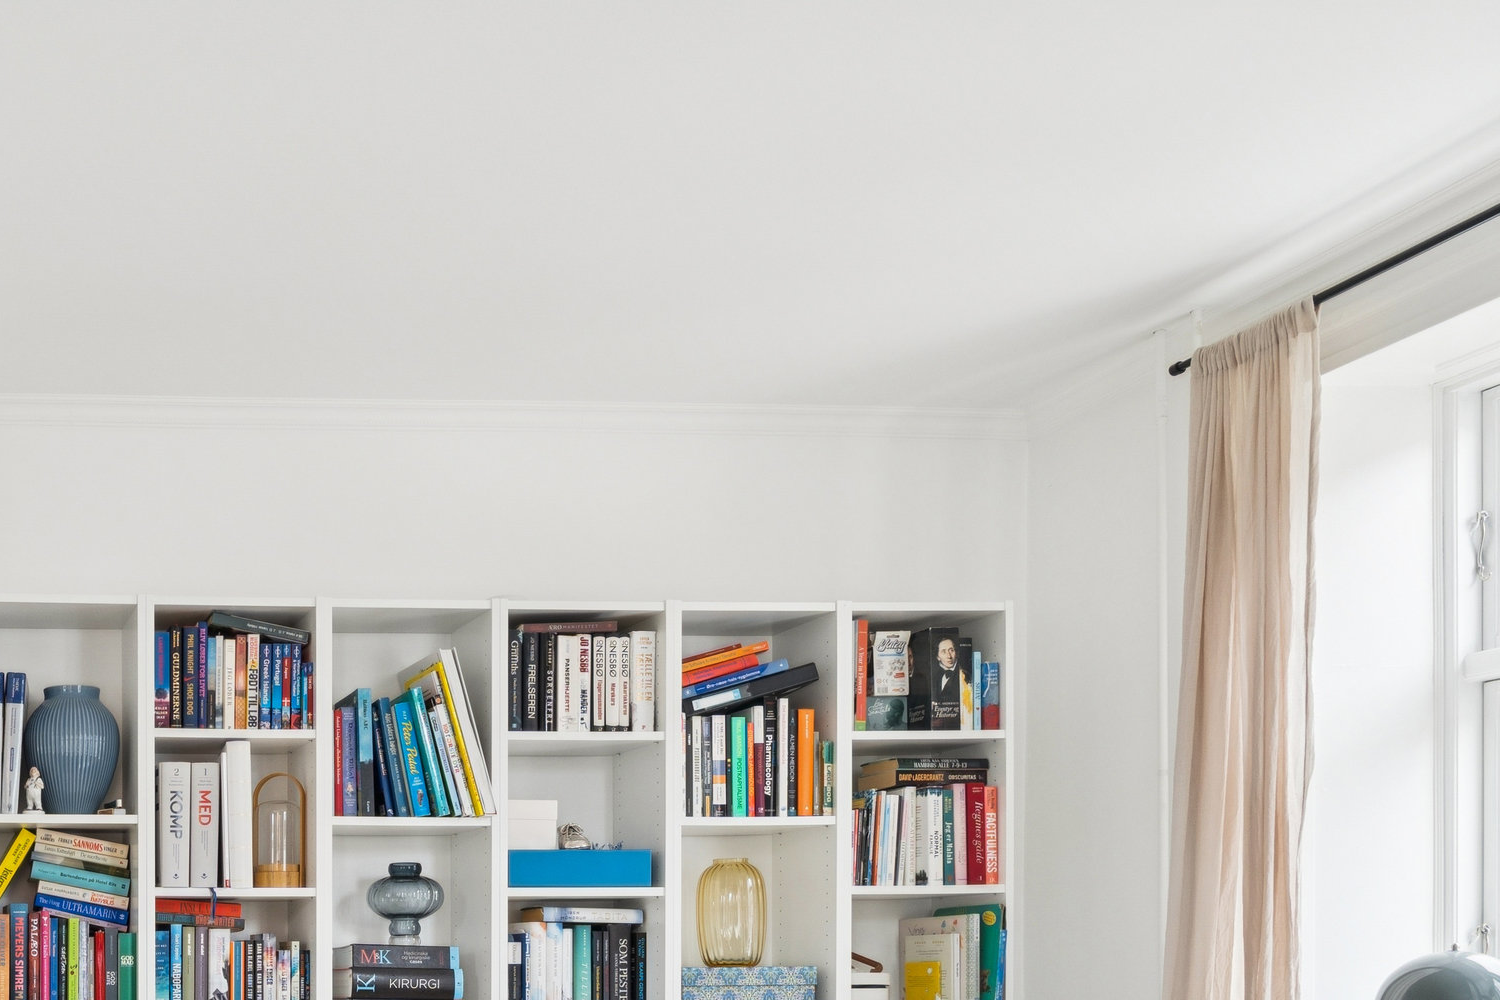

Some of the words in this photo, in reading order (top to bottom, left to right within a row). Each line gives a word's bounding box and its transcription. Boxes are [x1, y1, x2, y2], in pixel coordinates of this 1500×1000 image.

[580, 637, 589, 646] JO
[877, 639, 907, 654] Yatzy
[172, 652, 180, 720] GULDMINERNE
[249, 669, 258, 693] FØDT
[249, 695, 257, 708] TIL
[646, 692, 652, 701] EN
[248, 710, 258, 727] LØB
[402, 721, 411, 745] Peter
[407, 747, 419, 775] Pedal
[174, 768, 179, 776] 2
[764, 735, 772, 796] Pharmacology
[170, 791, 182, 839] KOMP
[199, 790, 211, 826] MED
[972, 802, 983, 838] Regines
[72, 839, 103, 852] SANNOMS
[972, 840, 984, 864] gåde
[986, 813, 997, 873] FACTFULNESS
[61, 903, 117, 919] ULTRAMARIN
[15, 917, 24, 958] MEYERS
[619, 939, 628, 964] SOM
[357, 974, 375, 992] K
[389, 979, 440, 989] KIRURGI
